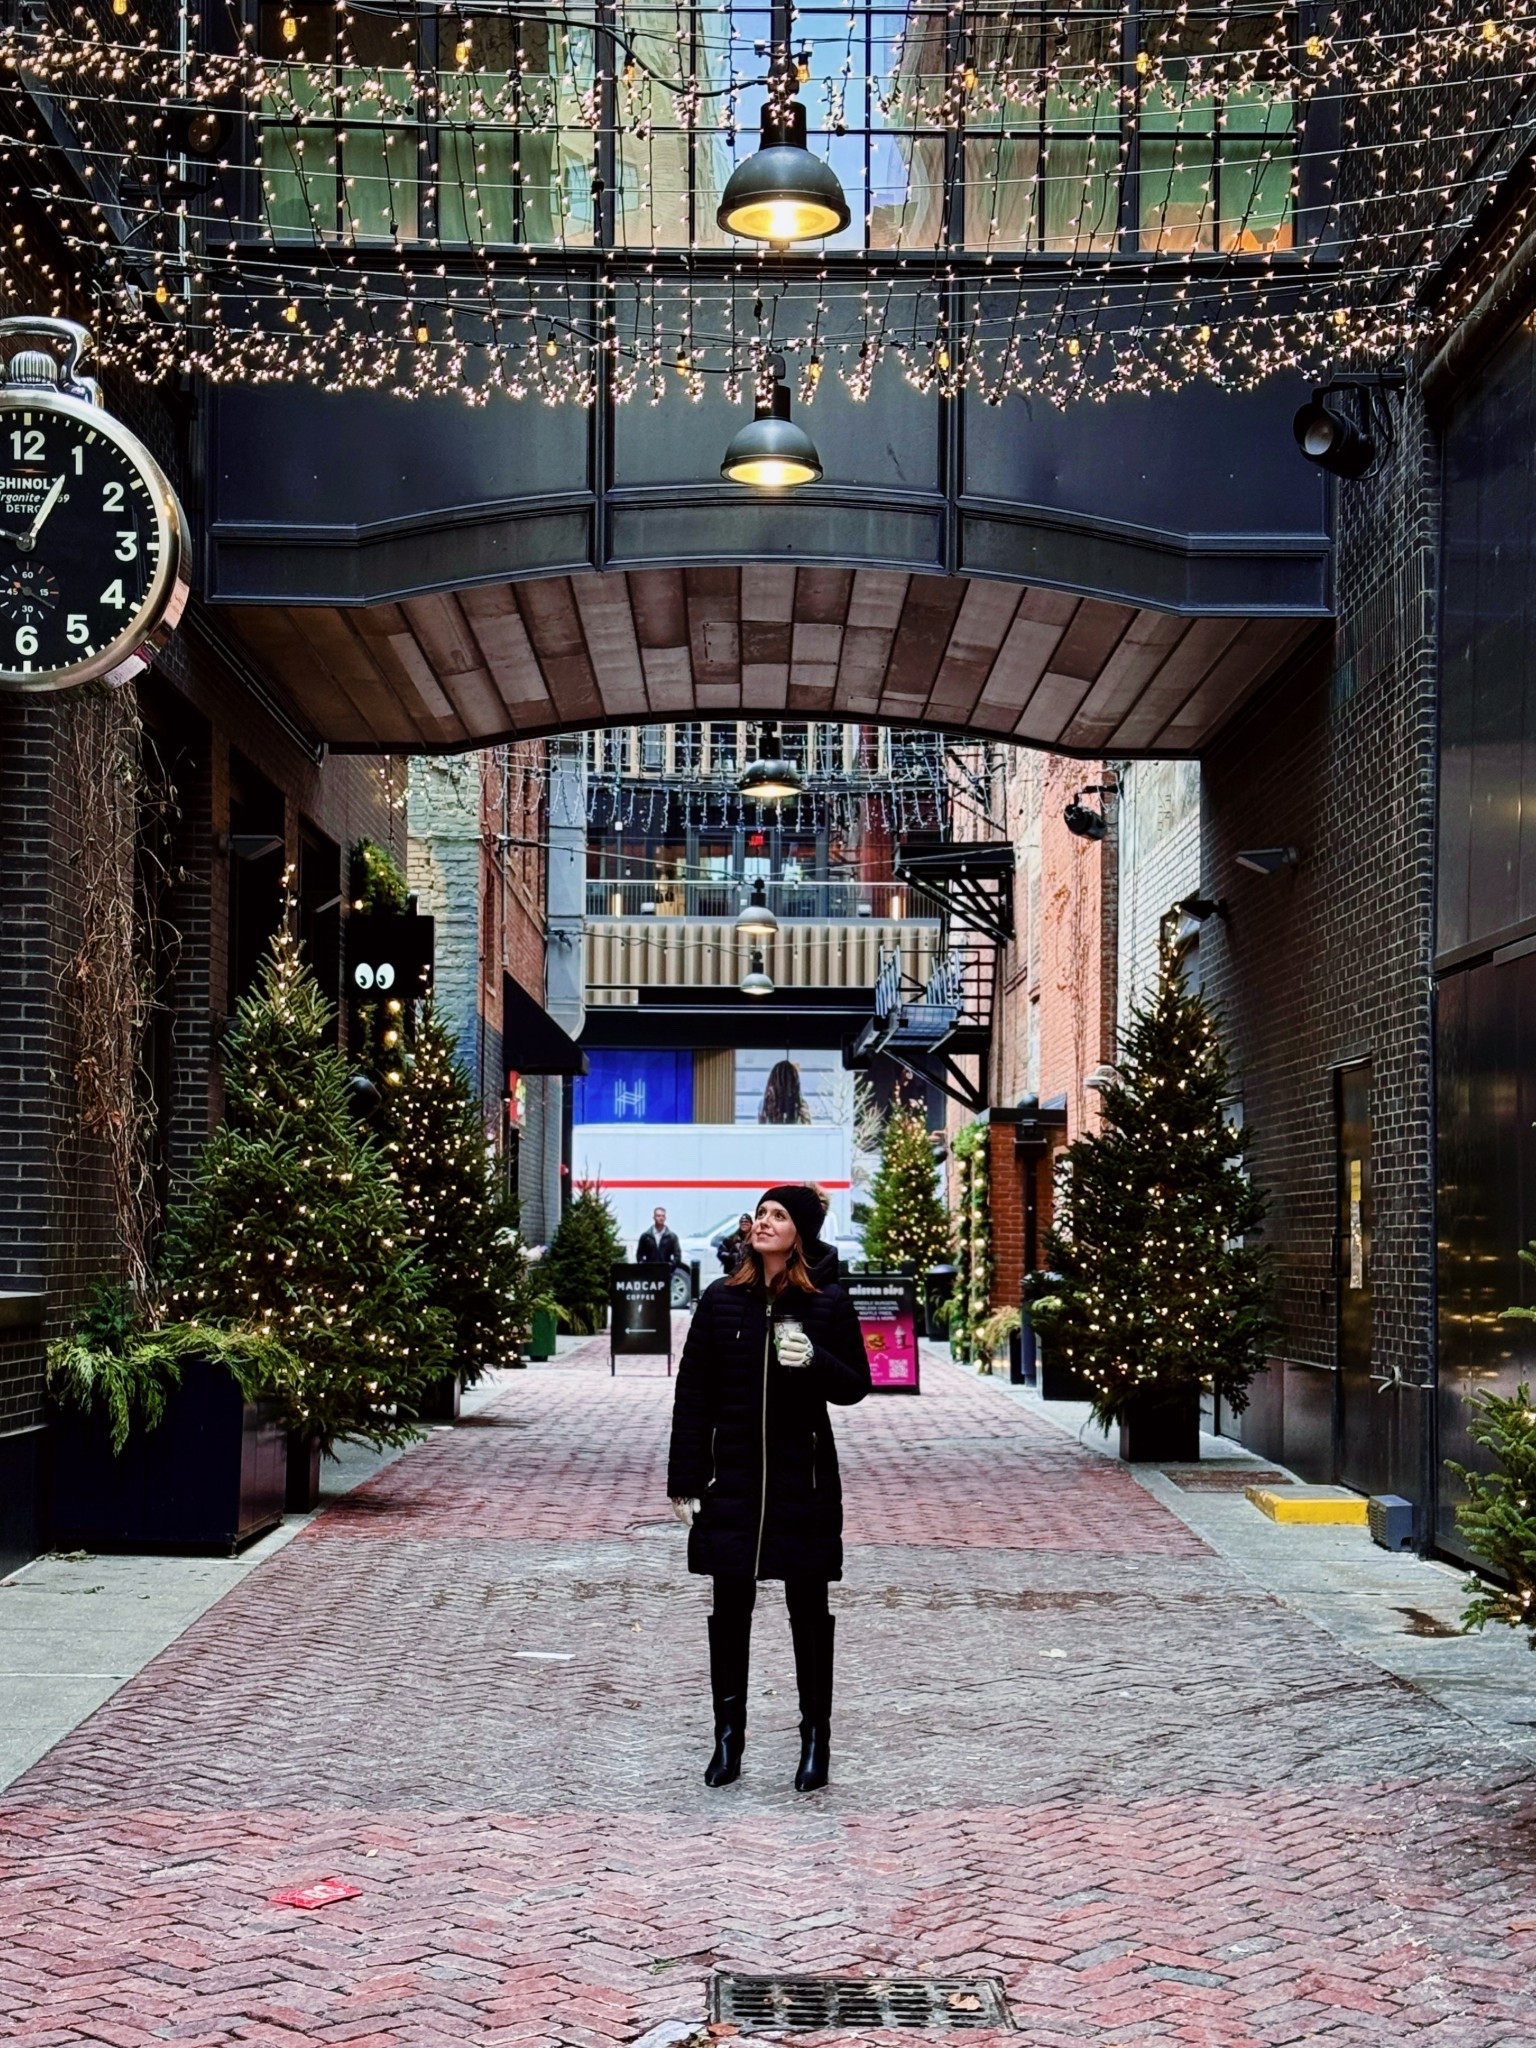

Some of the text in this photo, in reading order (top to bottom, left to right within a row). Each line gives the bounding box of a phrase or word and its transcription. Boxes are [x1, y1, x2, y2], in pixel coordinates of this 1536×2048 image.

[10, 430, 46, 461] 12
[71, 445, 83, 476] 1
[0, 476, 58, 490] SHINOL
[102, 481, 125, 512] 2
[114, 531, 138, 562] 3
[22, 571, 34, 579] 60
[6, 588, 19, 596] 45
[40, 588, 49, 596] 15
[100, 579, 126, 610] 4
[21, 605, 34, 613] 30
[15, 625, 39, 656] 6
[66, 614, 90, 645] 5
[616, 1281, 666, 1291] MADCAP
